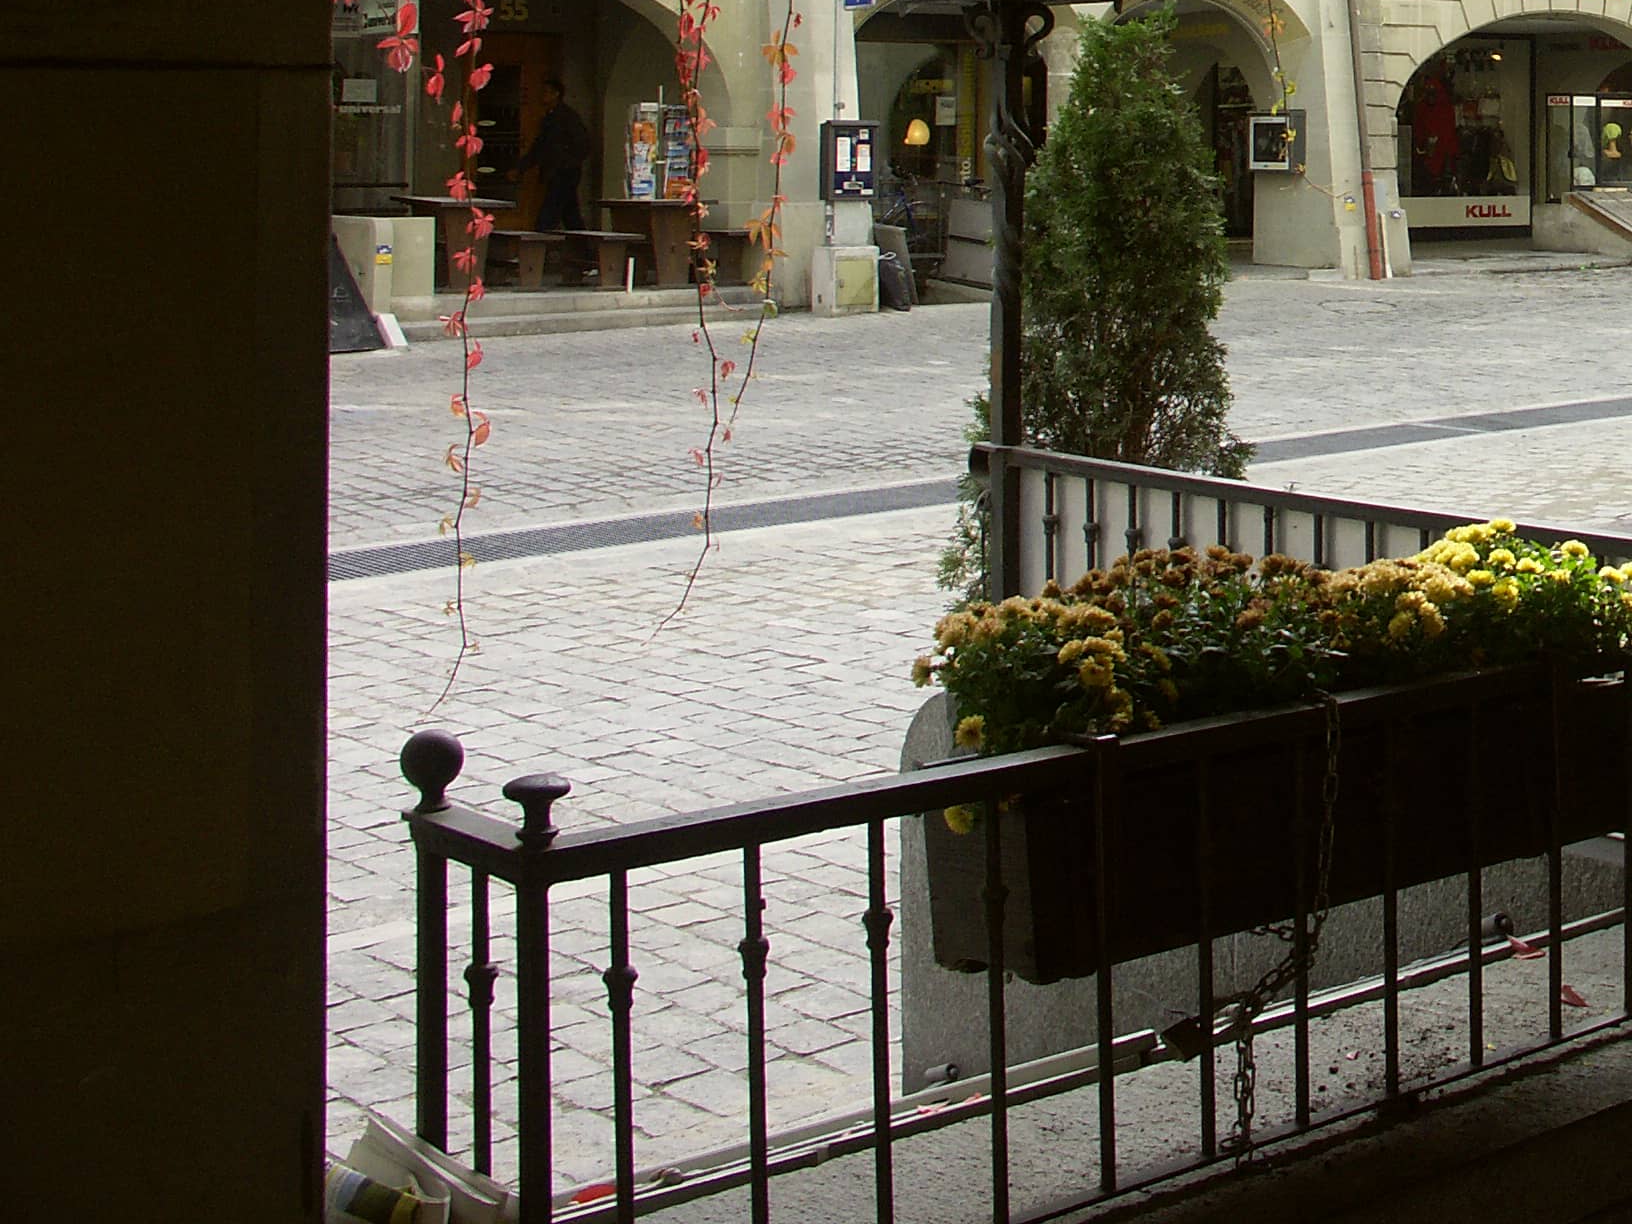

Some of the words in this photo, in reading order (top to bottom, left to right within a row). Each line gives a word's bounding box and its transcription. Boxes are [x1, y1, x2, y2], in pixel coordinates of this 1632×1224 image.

[500, 0, 529, 21] 55
[1549, 96, 1569, 105] KULL
[1465, 204, 1512, 218] KULL
